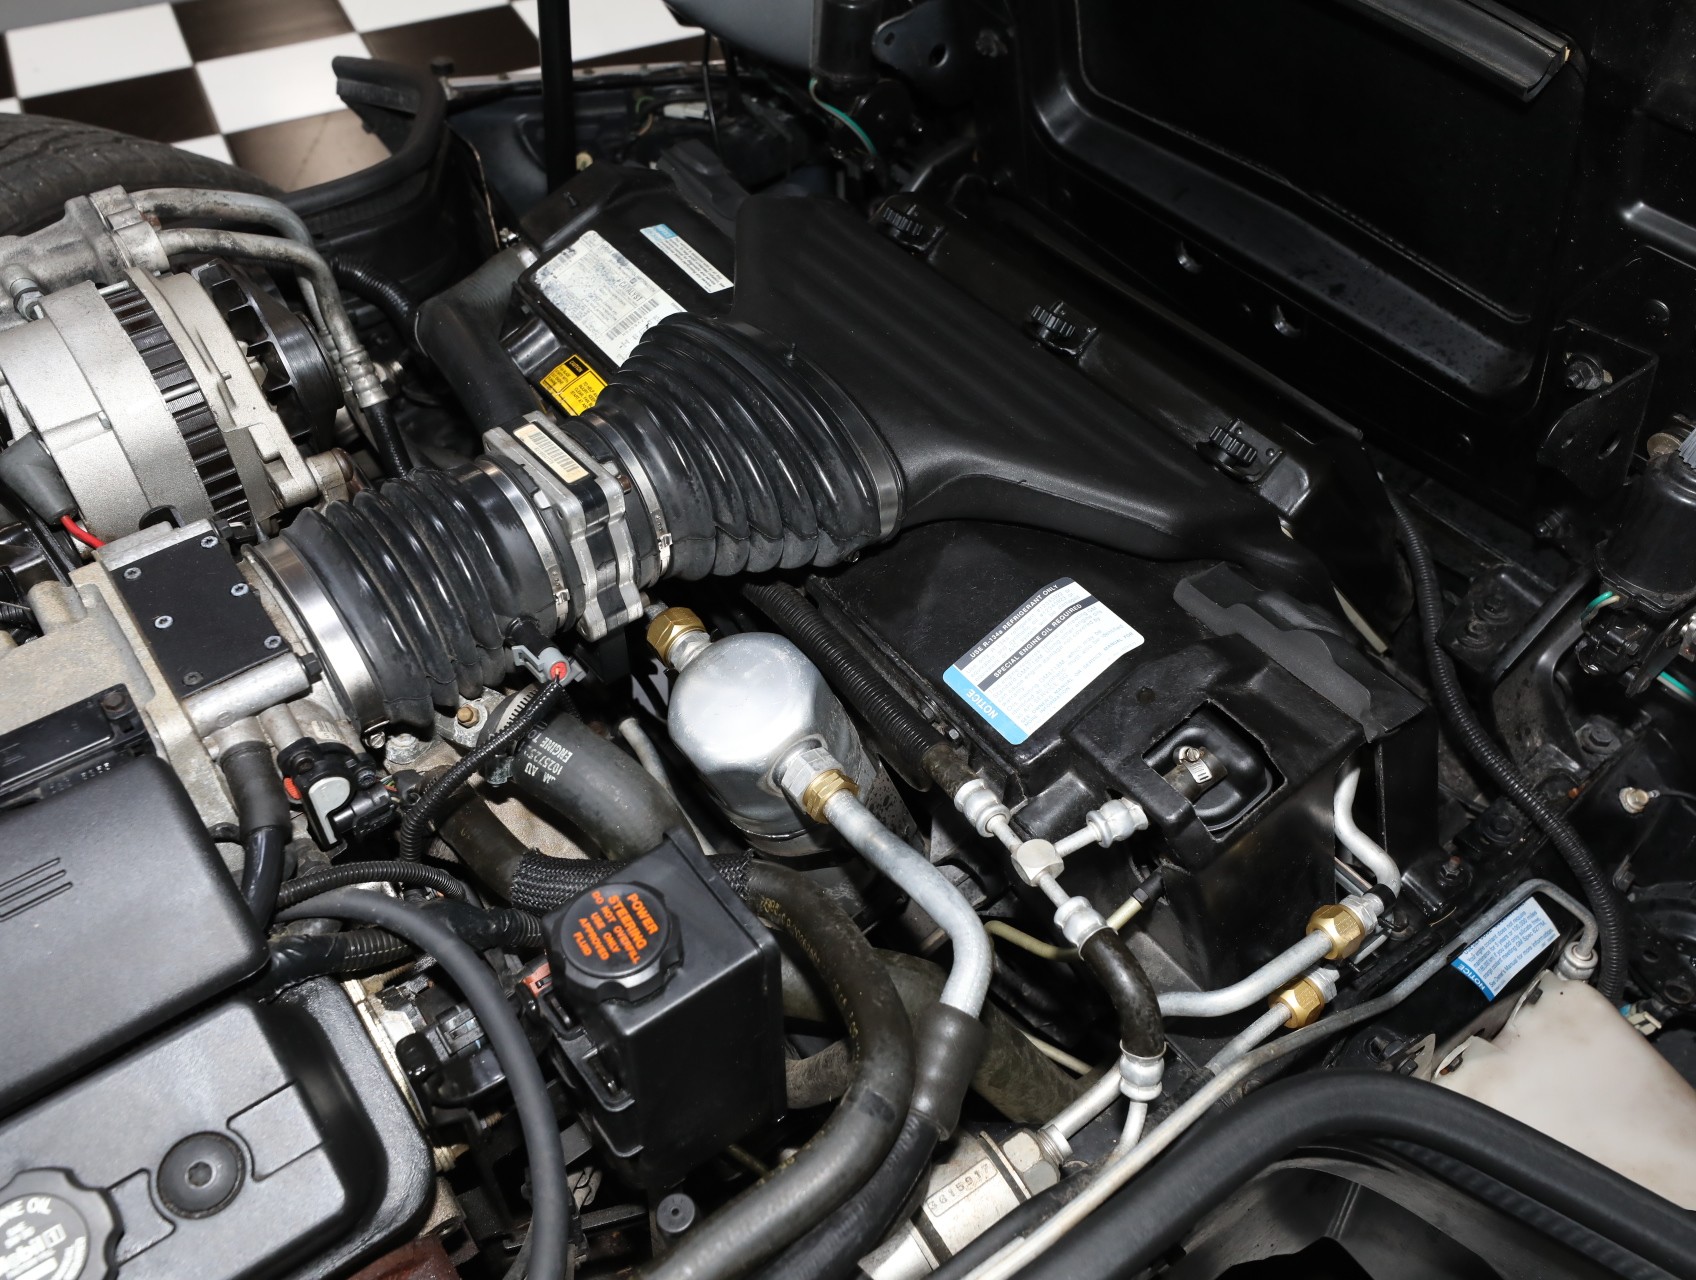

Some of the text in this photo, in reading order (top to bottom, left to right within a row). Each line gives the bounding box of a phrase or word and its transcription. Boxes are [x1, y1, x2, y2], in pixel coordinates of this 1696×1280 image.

[970, 647, 983, 658] USE
[1003, 595, 1042, 630] REFRIGERANT
[1043, 584, 1058, 595] ONLY
[993, 603, 1082, 678] SPECIAL ENGINE OIL REQUIRED
[966, 688, 999, 720] NOTICE
[540, 737, 573, 763] ENGINE
[591, 911, 621, 953] USE ONLY
[592, 890, 641, 965] DO NOT OVERFILL
[608, 895, 647, 950] STEERING
[627, 892, 659, 935] POWER
[572, 931, 592, 956] FLUID
[579, 918, 609, 961] APPROVED
[1458, 963, 1485, 991] NOTICE
